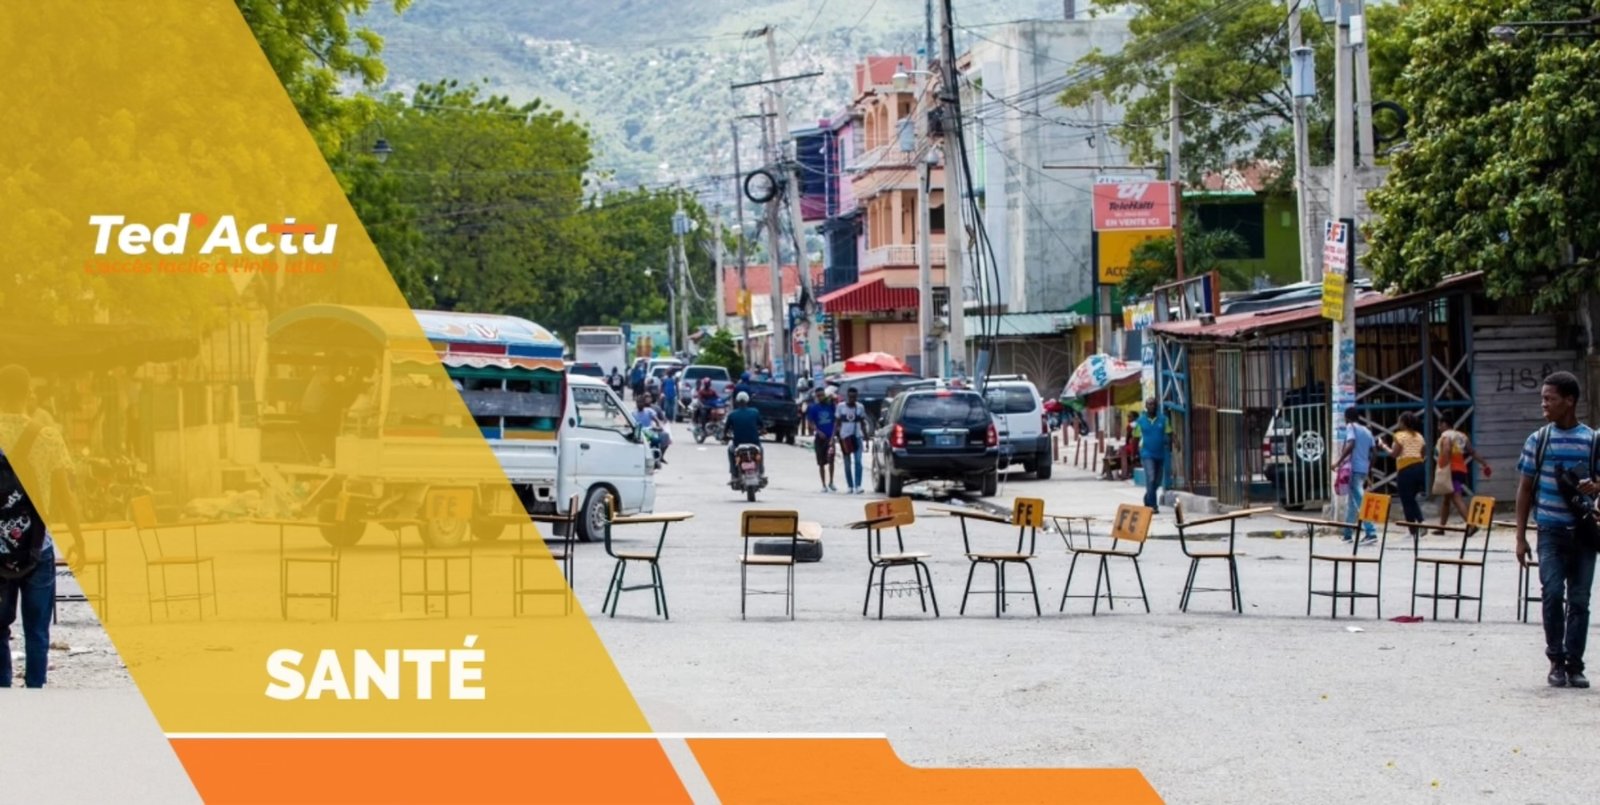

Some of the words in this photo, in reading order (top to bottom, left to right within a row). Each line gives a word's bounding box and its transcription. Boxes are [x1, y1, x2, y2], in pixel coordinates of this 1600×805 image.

[1119, 218, 1147, 226] VENTE
[1016, 502, 1034, 525] FE
[1364, 497, 1381, 520] FE
[1471, 501, 1487, 525] FE
[1118, 508, 1141, 533] FE
